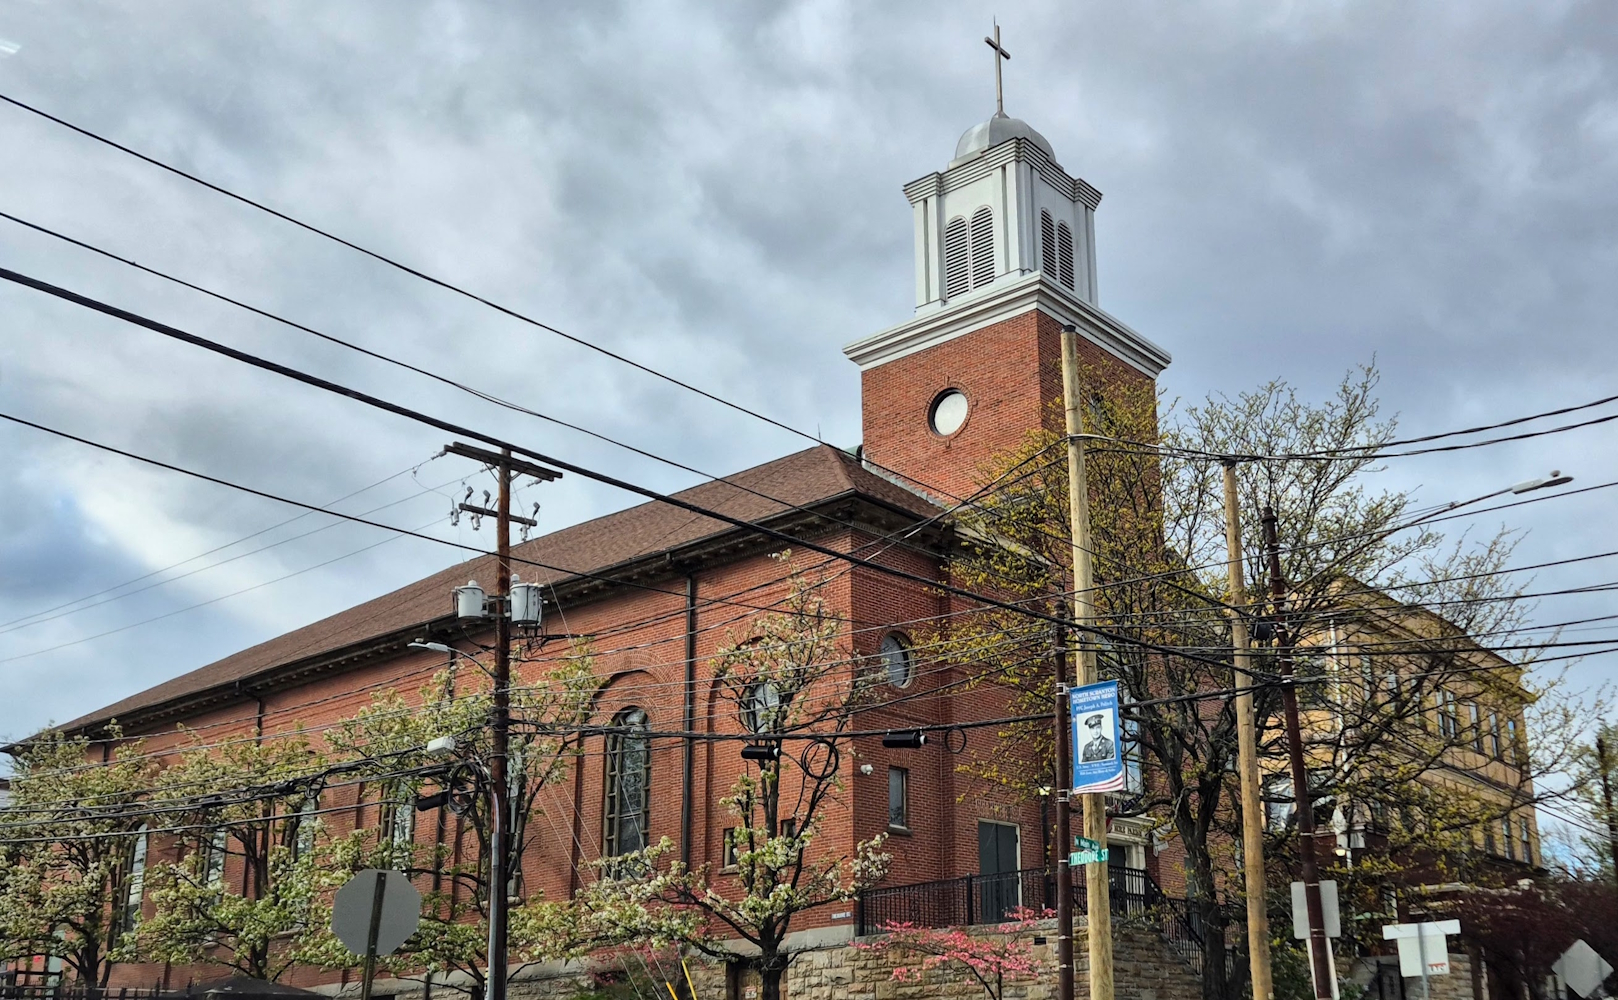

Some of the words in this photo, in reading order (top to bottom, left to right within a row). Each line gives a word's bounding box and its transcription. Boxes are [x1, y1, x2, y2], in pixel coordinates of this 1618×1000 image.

[1072, 690, 1089, 699] NORTH
[1089, 687, 1116, 697] SCRANTON
[1072, 695, 1101, 704] HOMETOWN
[1101, 692, 1116, 700] HERO
[1080, 838, 1091, 849] Main
[1070, 850, 1099, 865] THEODORE
[1101, 849, 1109, 862] ST
